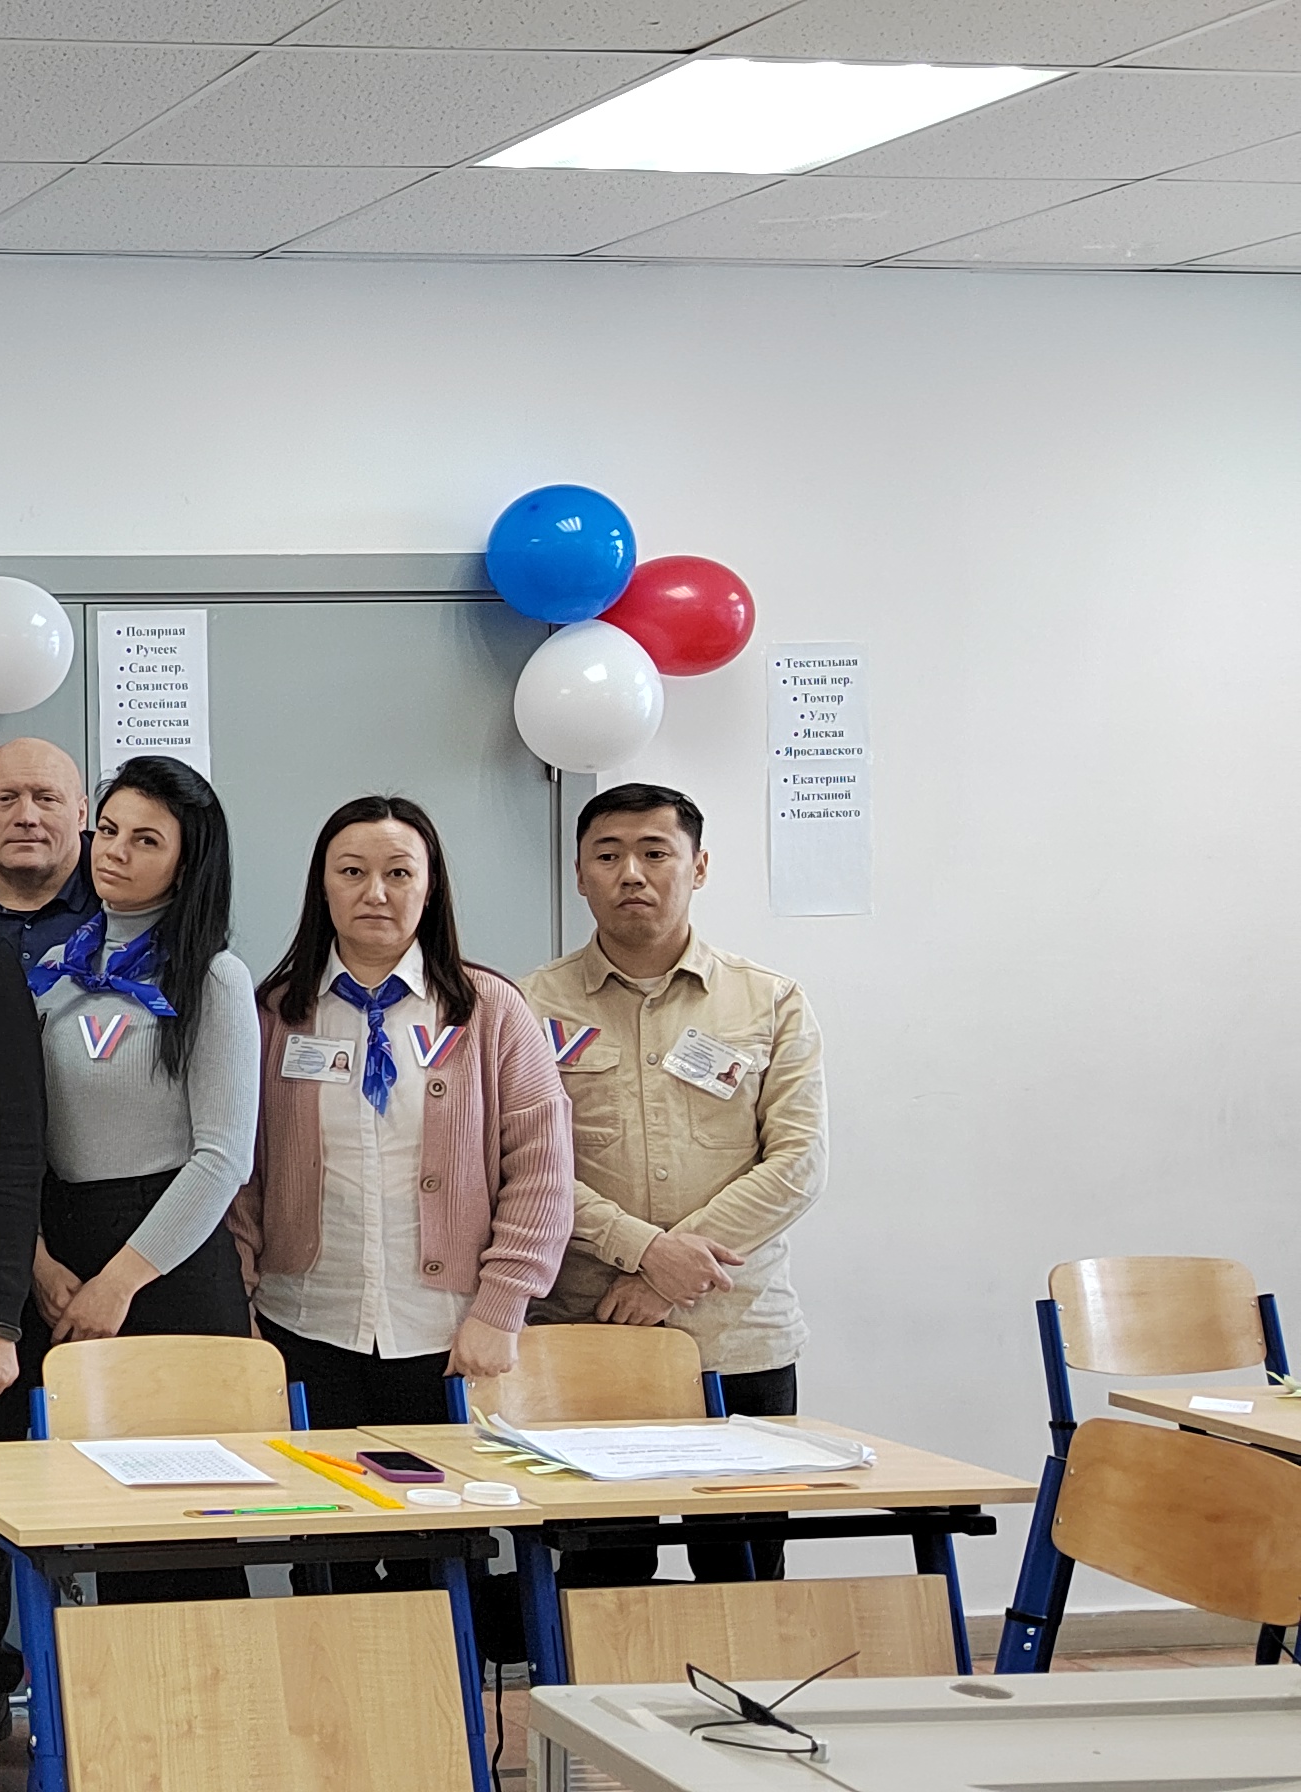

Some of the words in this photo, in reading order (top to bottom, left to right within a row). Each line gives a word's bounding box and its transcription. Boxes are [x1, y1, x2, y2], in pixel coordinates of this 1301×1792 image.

[126, 626, 186, 639] Полярная
[136, 644, 178, 657] Ручеек
[128, 662, 158, 674] Саас
[161, 664, 185, 675] пер.
[784, 657, 858, 669] Текстильная
[125, 680, 189, 691] Связистов
[790, 675, 827, 686] Тихий
[830, 676, 853, 688] пер.
[128, 698, 187, 709] Семейная
[801, 692, 844, 705] Томтор
[126, 716, 190, 728] Советская
[809, 710, 838, 723] Улуу
[802, 728, 845, 738] Янская
[125, 734, 191, 746] Солнечная
[783, 746, 863, 759] Ярославского
[792, 774, 856, 787] Екатерины
[790, 789, 852, 801] Лыткиной
[789, 808, 861, 819] Можайского
